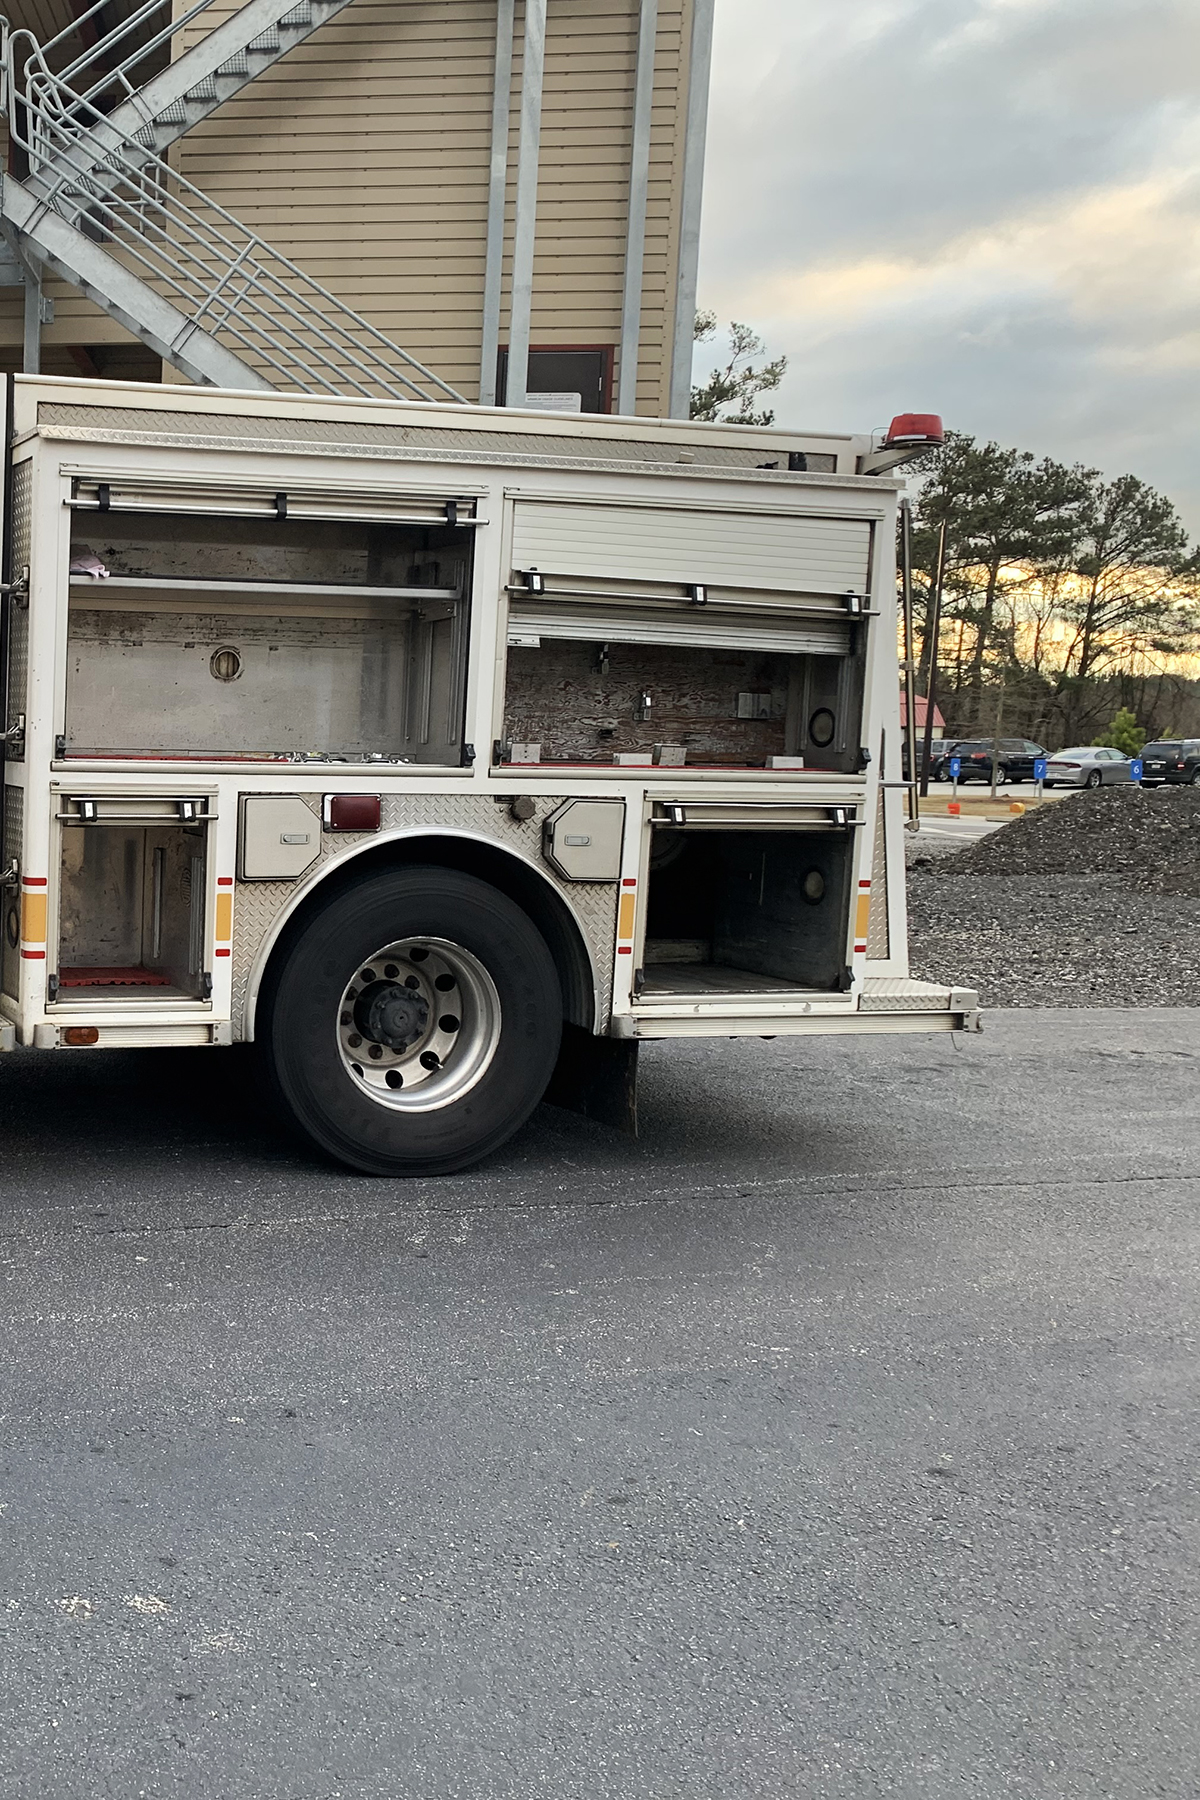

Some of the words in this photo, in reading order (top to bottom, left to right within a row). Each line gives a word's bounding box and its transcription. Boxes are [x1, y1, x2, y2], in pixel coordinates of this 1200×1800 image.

[953, 763, 959, 771] 8
[1037, 765, 1043, 773] 7
[1133, 765, 1140, 774] 6
